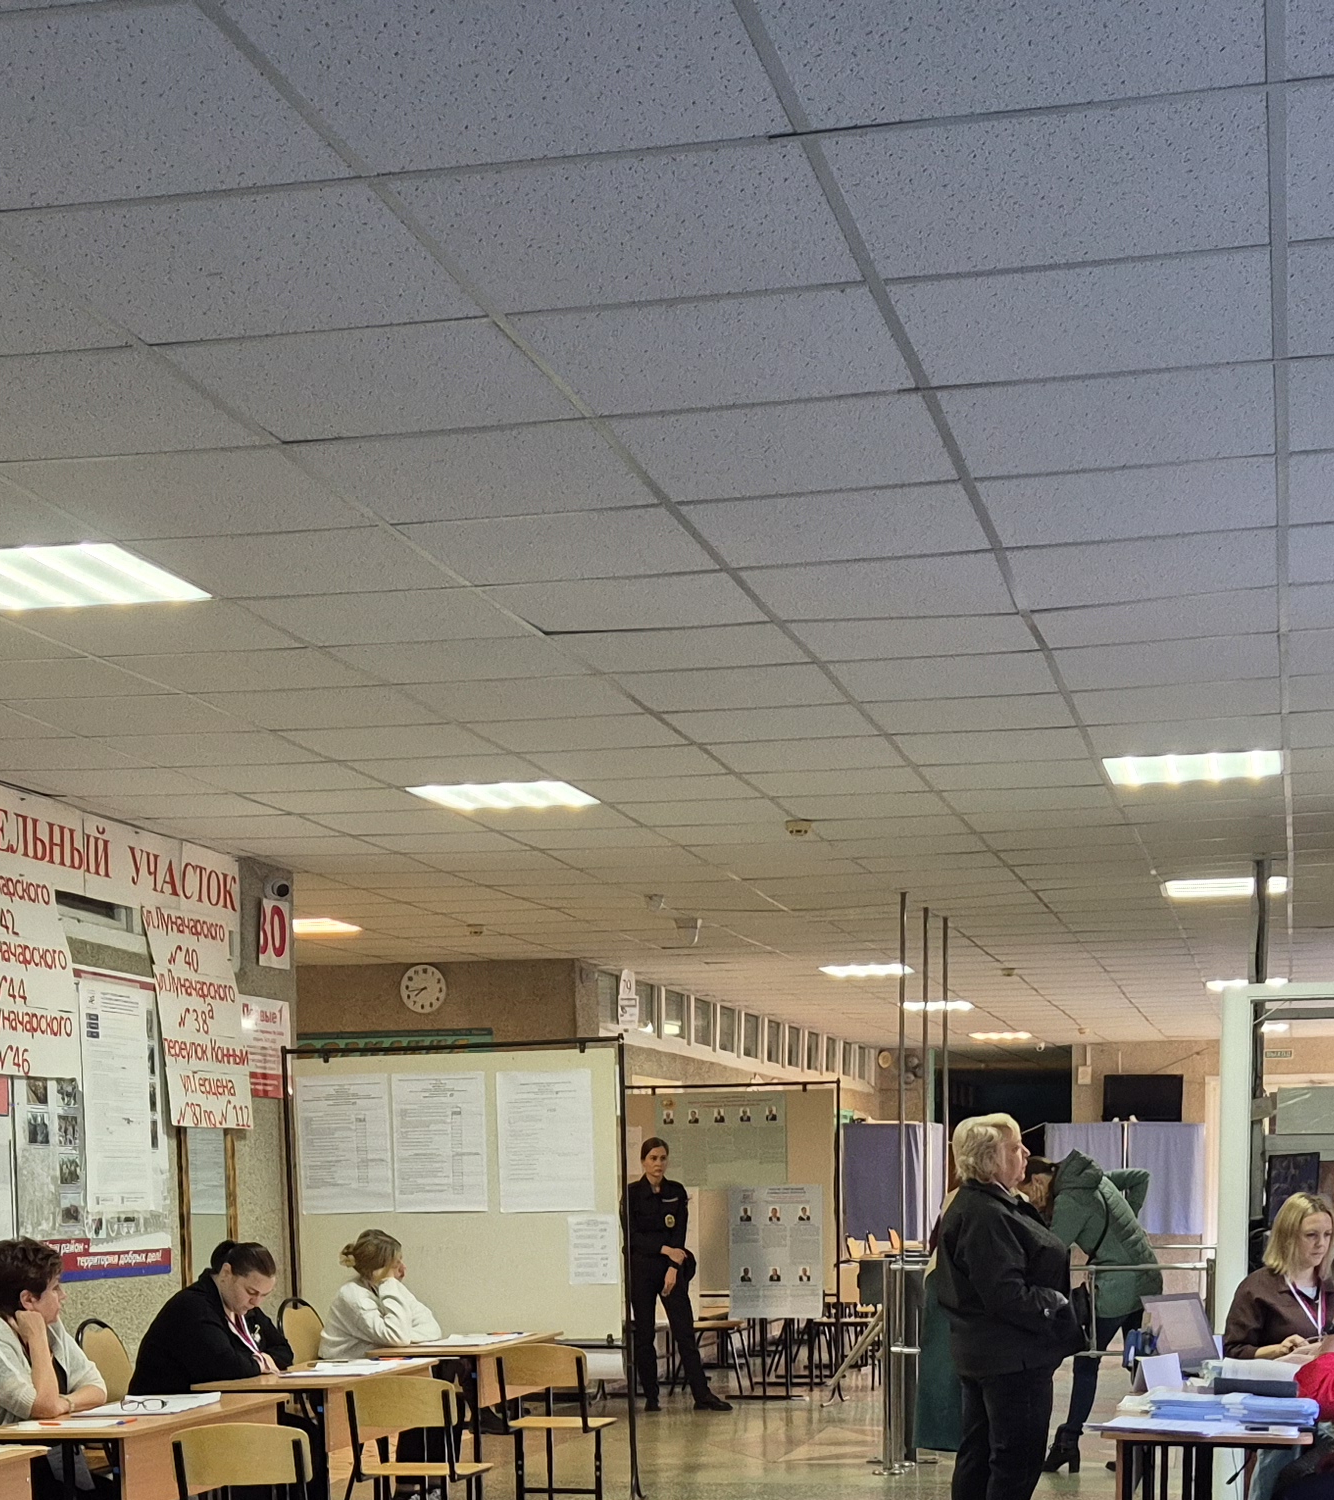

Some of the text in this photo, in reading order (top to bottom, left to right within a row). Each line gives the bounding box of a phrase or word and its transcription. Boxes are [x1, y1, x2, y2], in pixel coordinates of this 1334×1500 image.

[127, 845, 239, 913] УЧАСТОК
[155, 905, 226, 943] Луначарского
[167, 966, 236, 1005] Луначарского
[163, 1037, 208, 1063] переулок
[209, 1037, 249, 1067] Конный
[192, 1069, 237, 1101] Герцена
[60, 1239, 84, 1257] район
[119, 1250, 146, 1267] добрых
